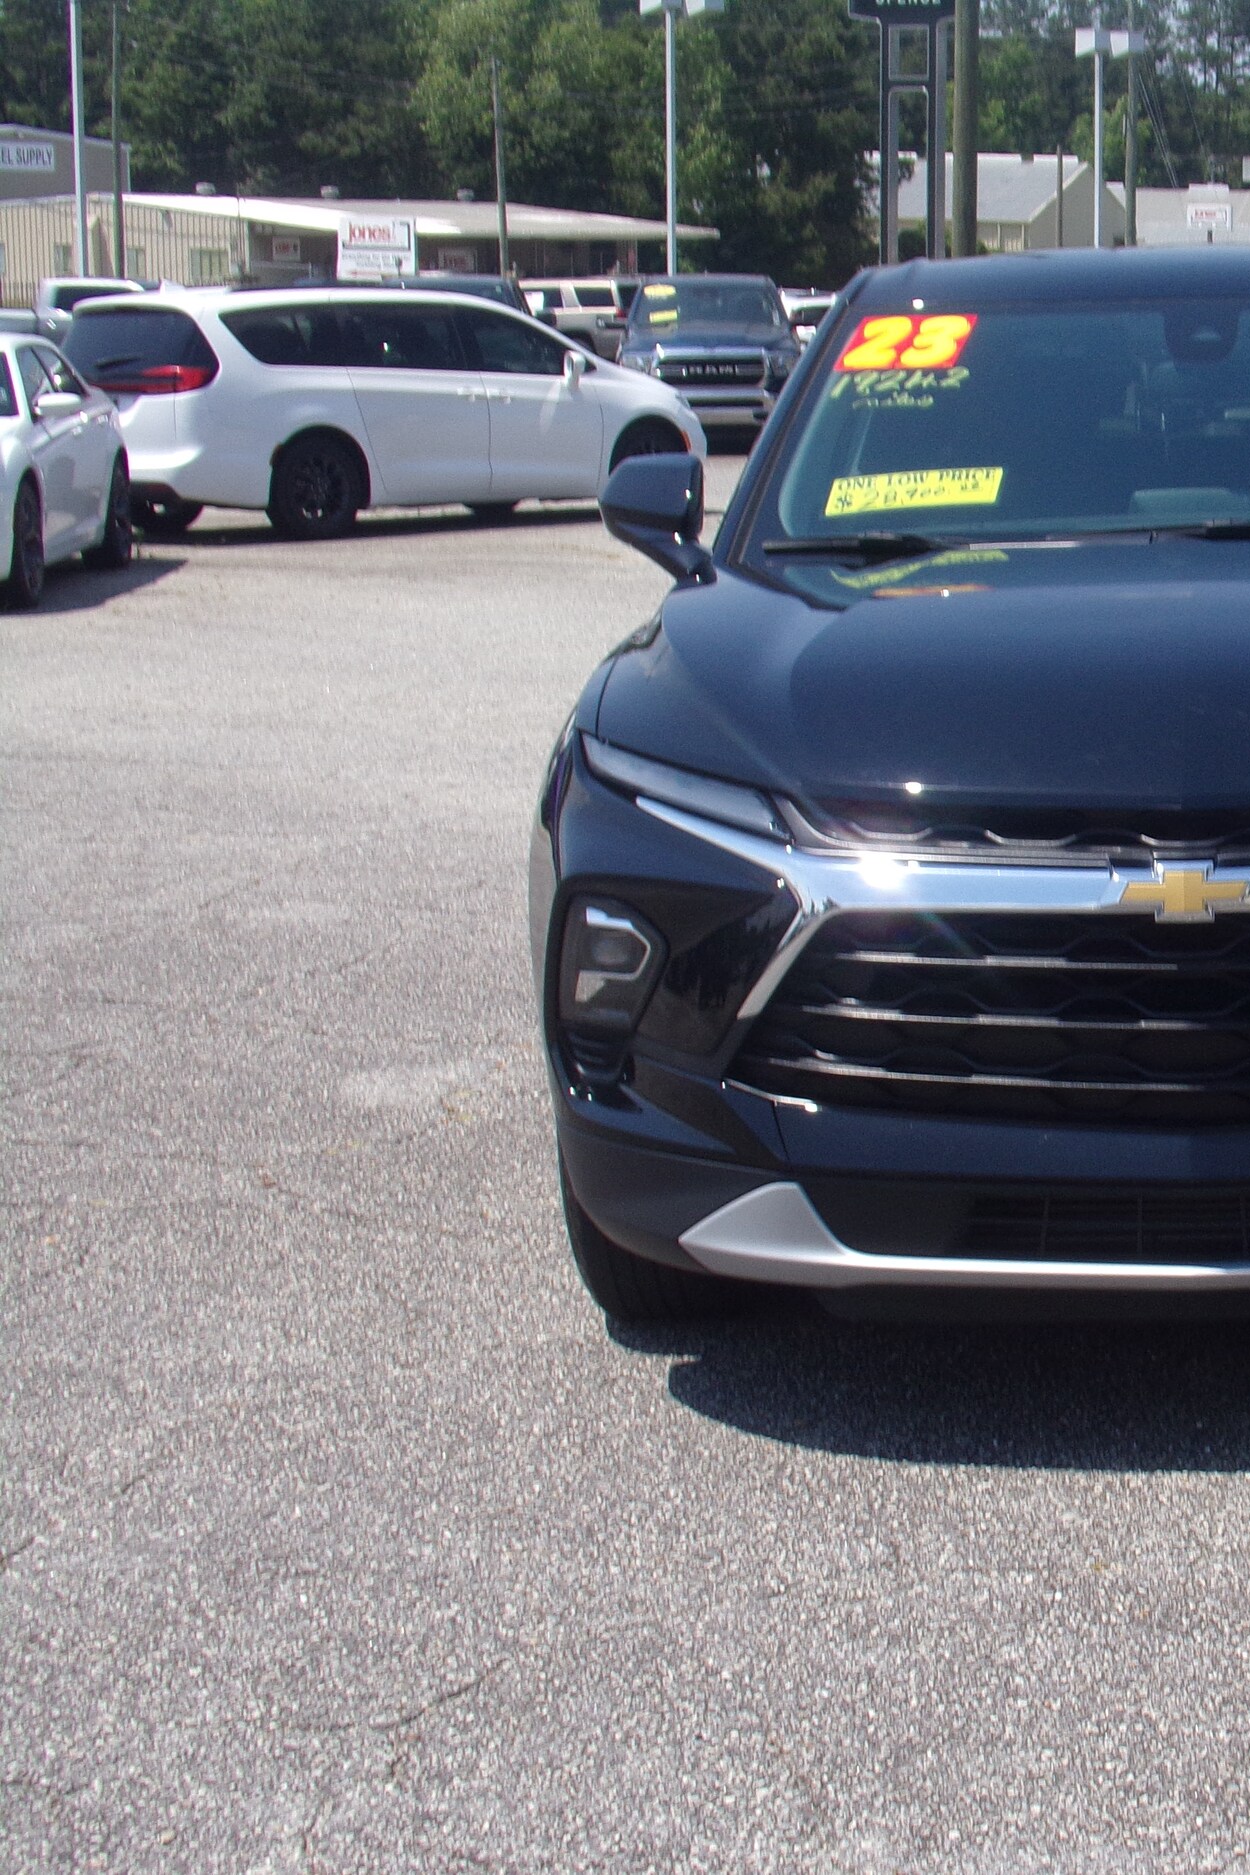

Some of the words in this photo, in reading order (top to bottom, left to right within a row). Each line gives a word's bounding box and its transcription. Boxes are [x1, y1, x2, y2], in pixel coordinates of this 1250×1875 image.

[16, 147, 53, 166] SUPPLY
[843, 315, 972, 368] 23
[838, 477, 876, 491] ONE
[887, 471, 929, 487] LOW
[938, 467, 997, 482] PRICE
